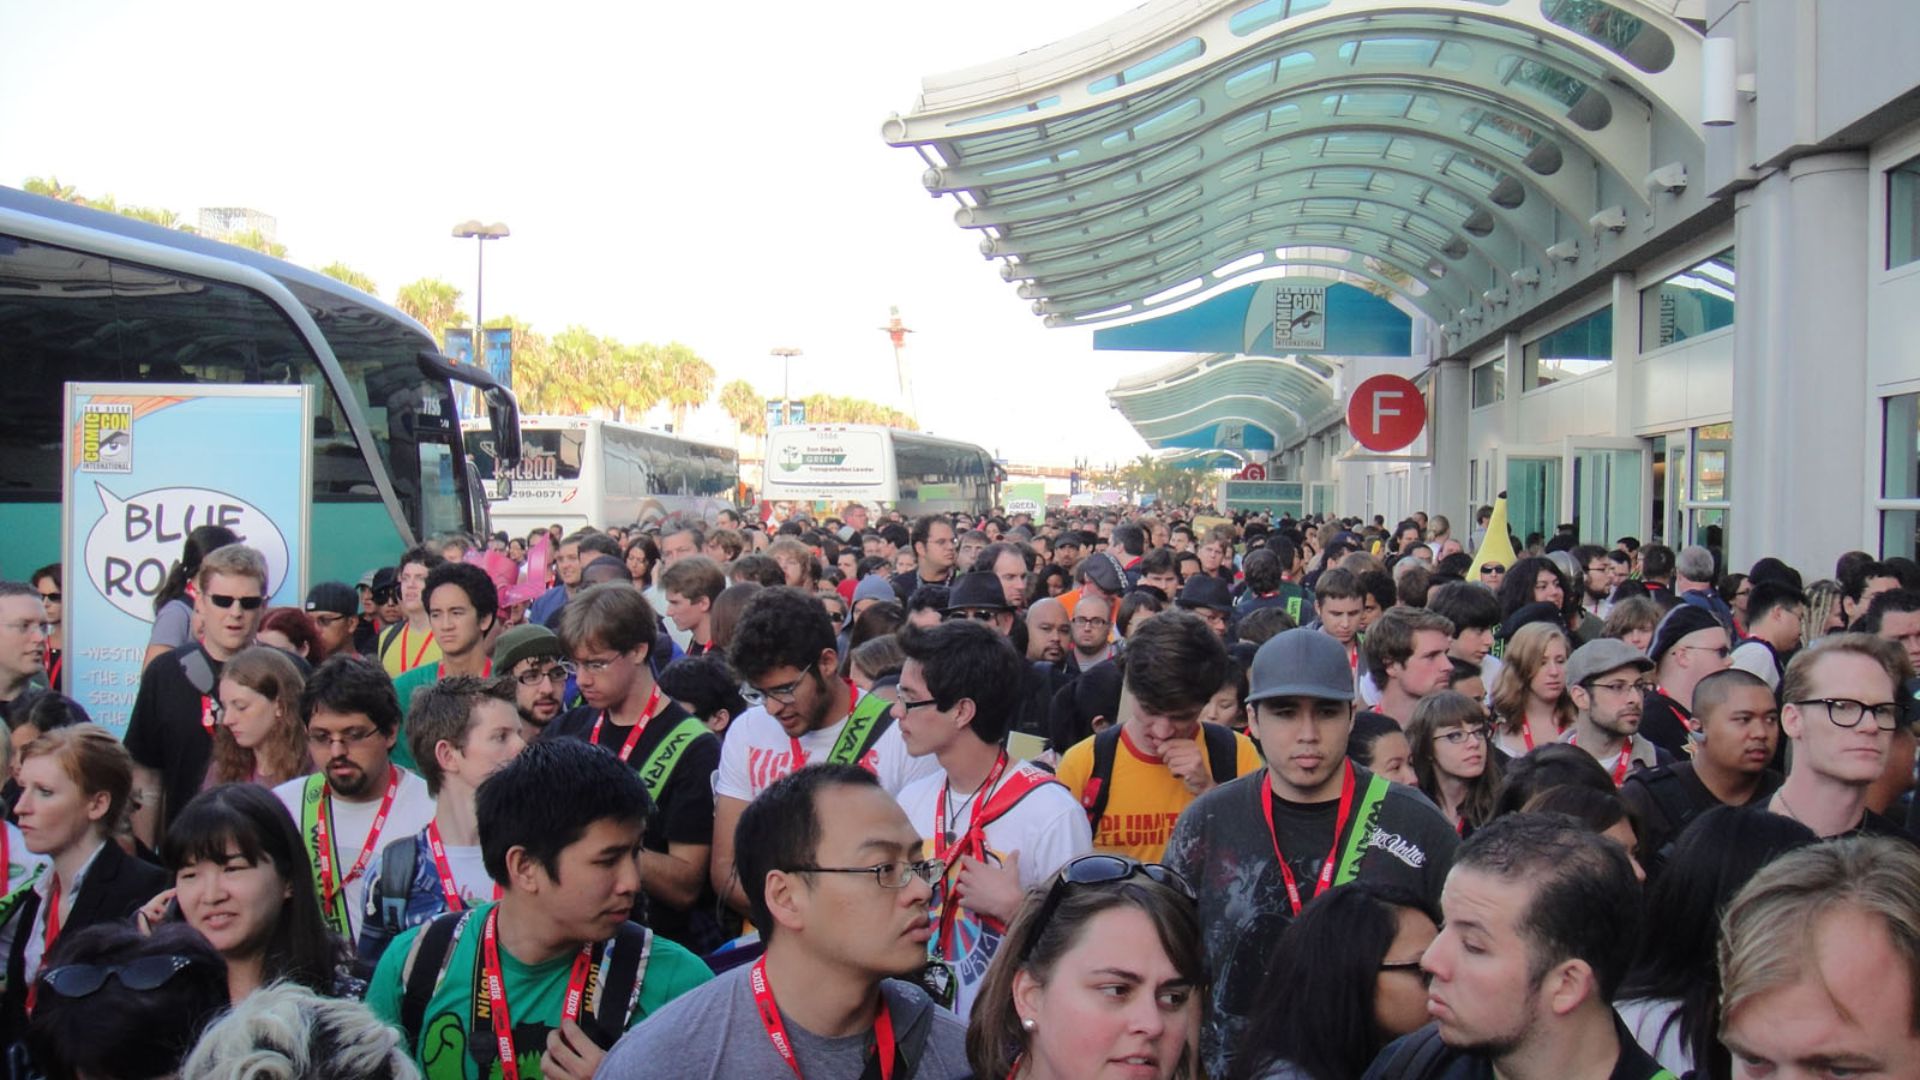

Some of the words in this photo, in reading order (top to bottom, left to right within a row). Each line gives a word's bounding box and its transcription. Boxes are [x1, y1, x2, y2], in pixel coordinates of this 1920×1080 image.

[1277, 294, 1292, 338] COMIC
[1293, 294, 1322, 313] CON
[101, 413, 129, 430] CON
[1372, 391, 1403, 434] F
[85, 413, 100, 462] COMIC
[83, 463, 129, 471] INTERNATIONAL
[806, 455, 836, 463] GREEN
[1248, 467, 1260, 480] G
[125, 503, 247, 543] BLUE
[478, 968, 490, 1018] Nikon
[489, 975, 502, 1001] DEXTER
[584, 963, 600, 1013] Nikon
[752, 967, 766, 995] DEXTER
[566, 988, 580, 1016] DEXTER
[499, 1036, 513, 1062] DEXTER
[771, 1031, 792, 1058] DEXTER
